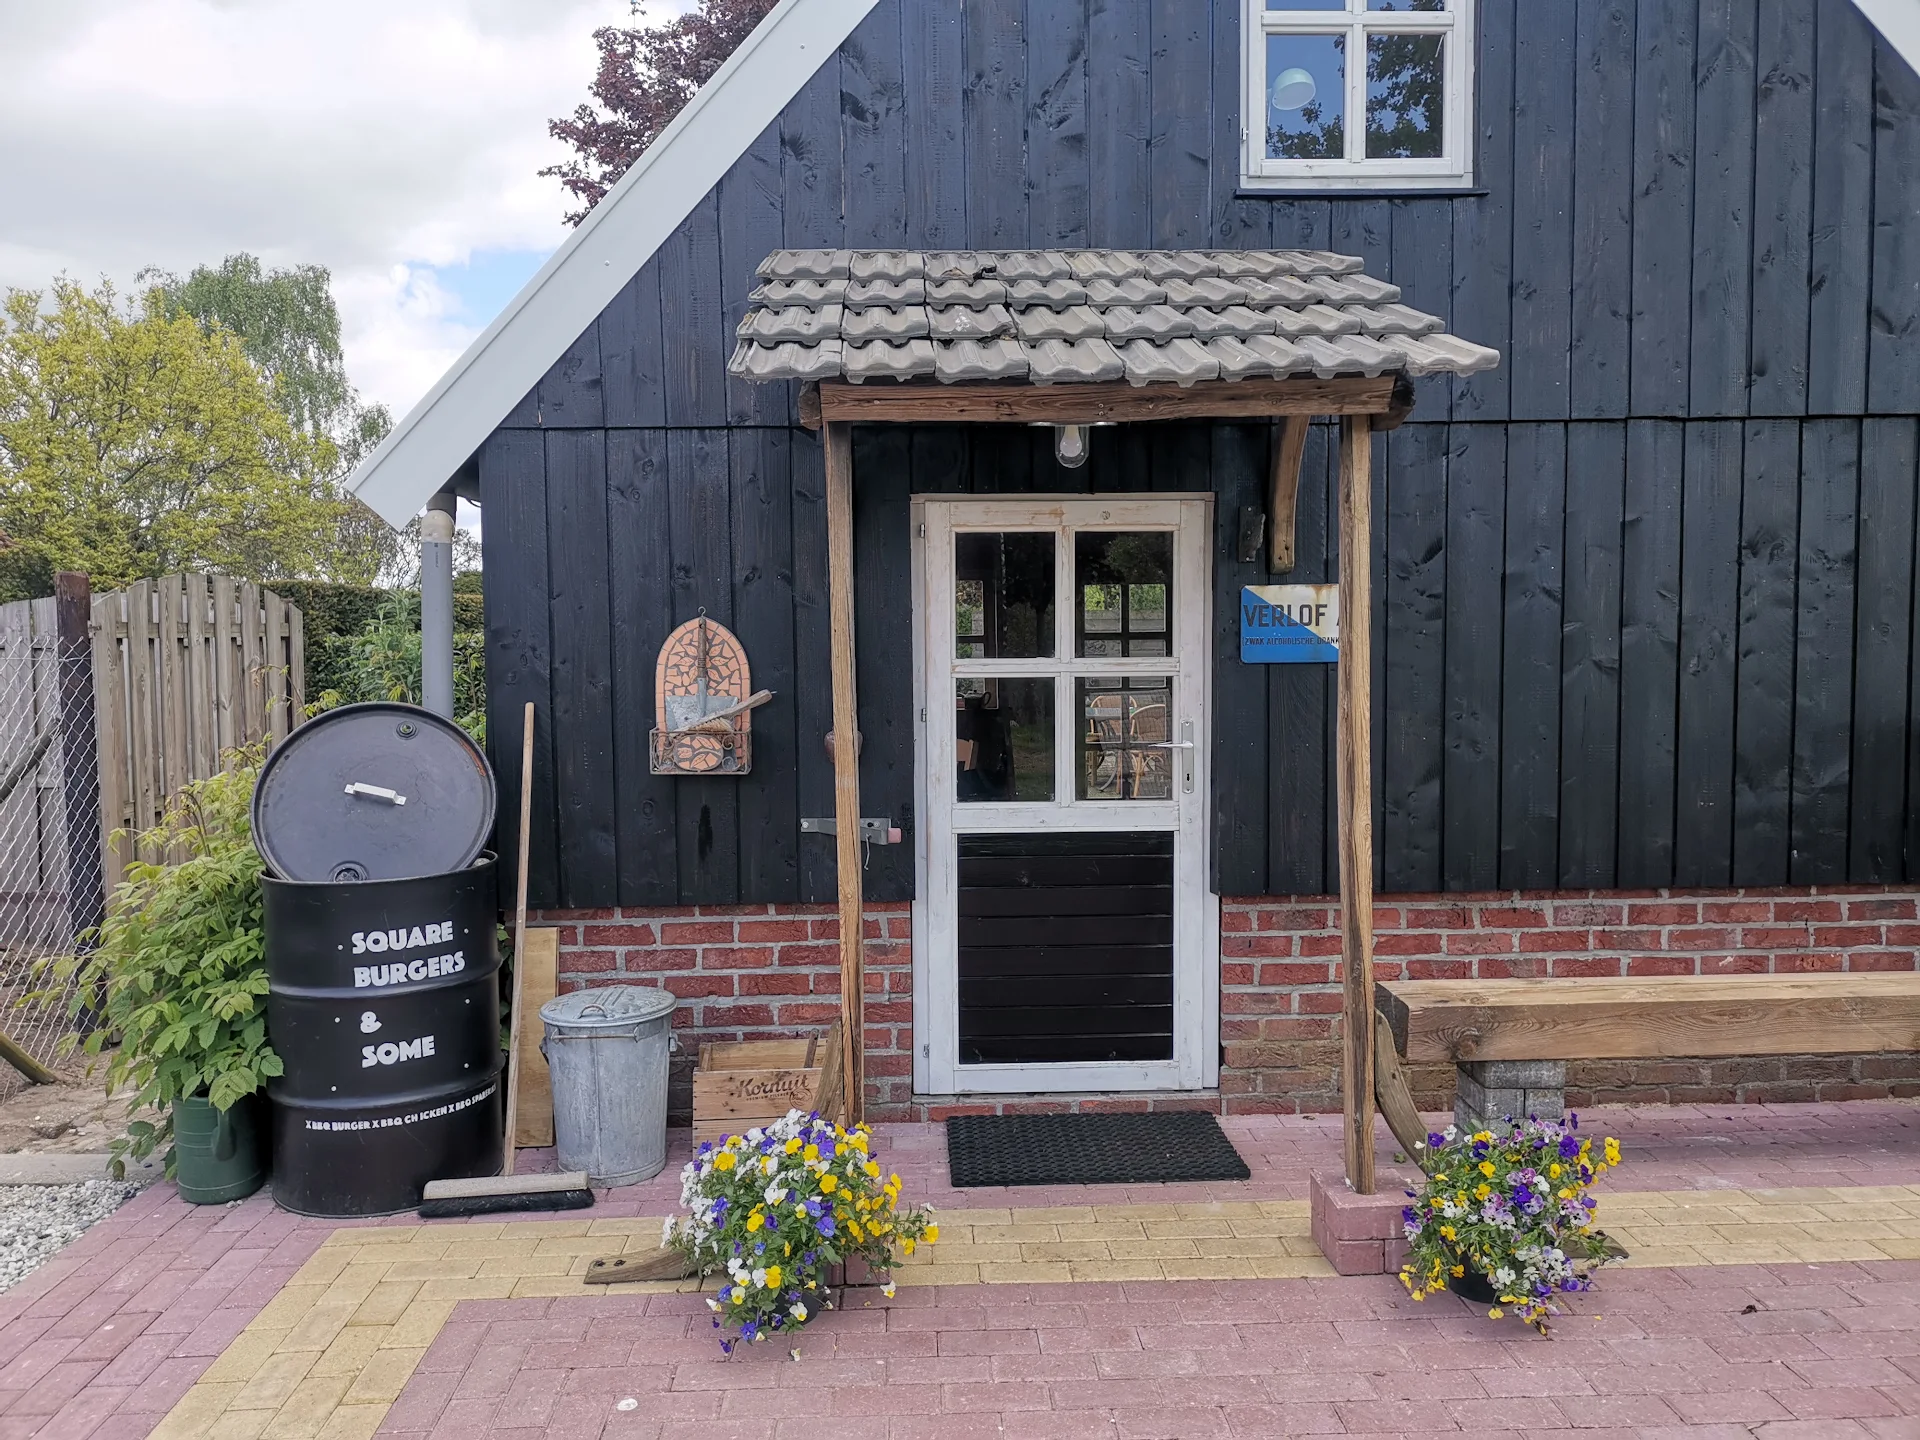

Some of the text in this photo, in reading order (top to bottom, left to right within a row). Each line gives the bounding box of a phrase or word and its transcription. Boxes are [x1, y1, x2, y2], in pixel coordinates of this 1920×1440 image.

[1243, 604, 1327, 627] VERLOF
[351, 921, 454, 954] SQUARE
[353, 951, 465, 988] BURGERS
[360, 1011, 383, 1034] &
[362, 1035, 436, 1068] SOME
[736, 1074, 810, 1098] Kornuit
[305, 1120, 312, 1129] X
[312, 1121, 331, 1130] BBQ
[332, 1120, 371, 1131] BURGER
[372, 1119, 380, 1129] X
[380, 1116, 404, 1128] BBQ
[448, 1104, 455, 1114] X
[455, 1098, 472, 1111] BBQ
